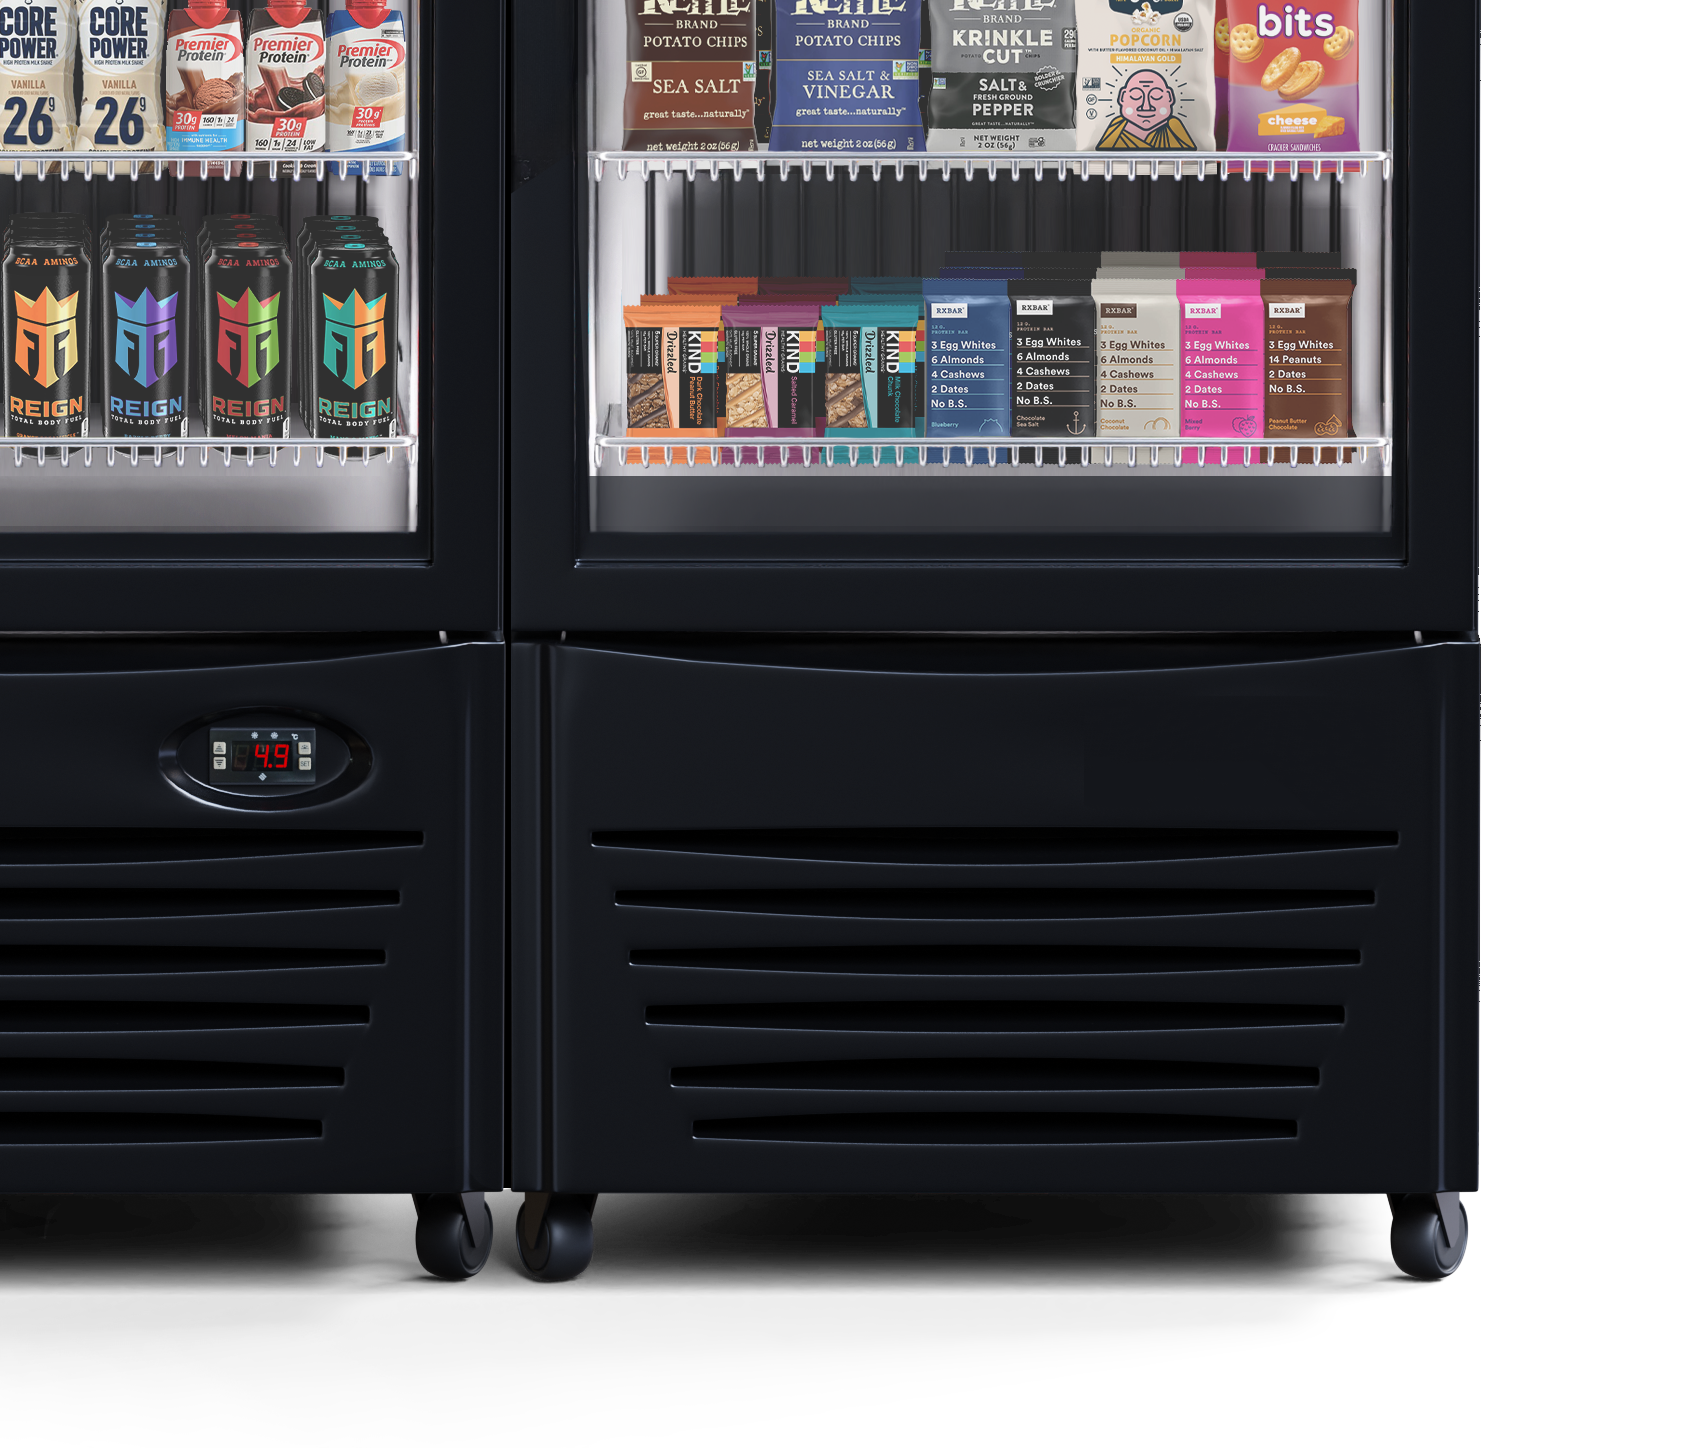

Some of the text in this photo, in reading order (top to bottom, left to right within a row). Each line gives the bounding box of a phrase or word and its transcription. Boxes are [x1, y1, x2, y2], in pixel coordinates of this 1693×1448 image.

[0, 6, 57, 36] CORE
[89, 6, 148, 36] CORE
[1258, 5, 1334, 37] bits
[0, 38, 56, 59] POWER
[89, 38, 147, 59] POWER
[176, 39, 229, 51] Premier
[254, 38, 313, 52] Premier
[644, 36, 748, 47] POTATO CHIPS
[178, 50, 224, 61] Protein
[259, 52, 307, 63] Protein
[338, 45, 392, 57] Premier
[340, 56, 386, 68] Protein
[11, 80, 46, 89] VANILLA
[803, 85, 895, 99] VINEGAR
[277, 119, 302, 132] 30g
[43, 257, 79, 266] AMINOS
[688, 331, 701, 373] KIND
[1269, 355, 1322, 364] 14 Peanuts
[1269, 384, 1306, 393] No B.S.
[10, 396, 83, 417] REIGN
[110, 396, 182, 417] REIGN
[213, 396, 284, 417] REIGN
[319, 397, 391, 418] REIGN
[254, 744, 290, 768] 4.9
